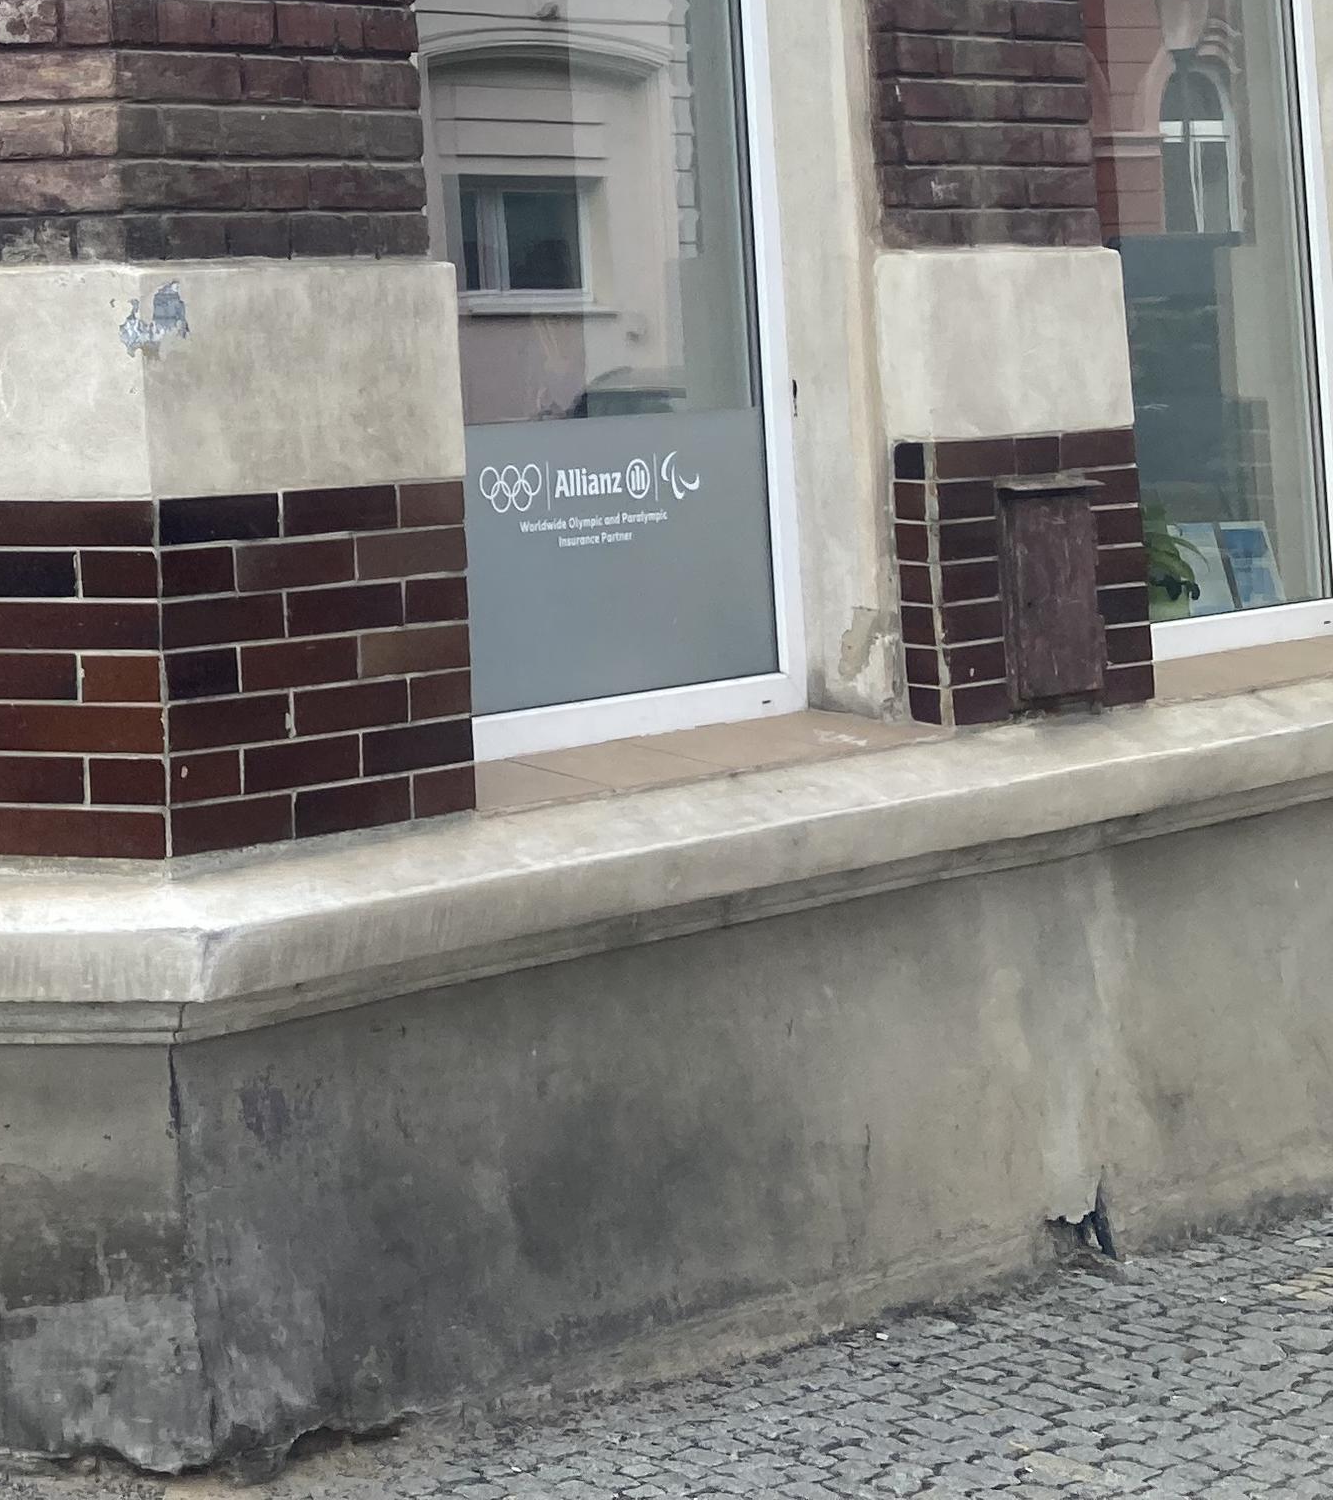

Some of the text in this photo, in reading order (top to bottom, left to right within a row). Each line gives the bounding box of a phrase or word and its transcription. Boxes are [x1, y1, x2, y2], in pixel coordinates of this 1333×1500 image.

[554, 467, 622, 498] Allianz
[519, 509, 668, 532] Worldwide Olympic and Paralympic
[558, 531, 632, 548] Insurance Partner
